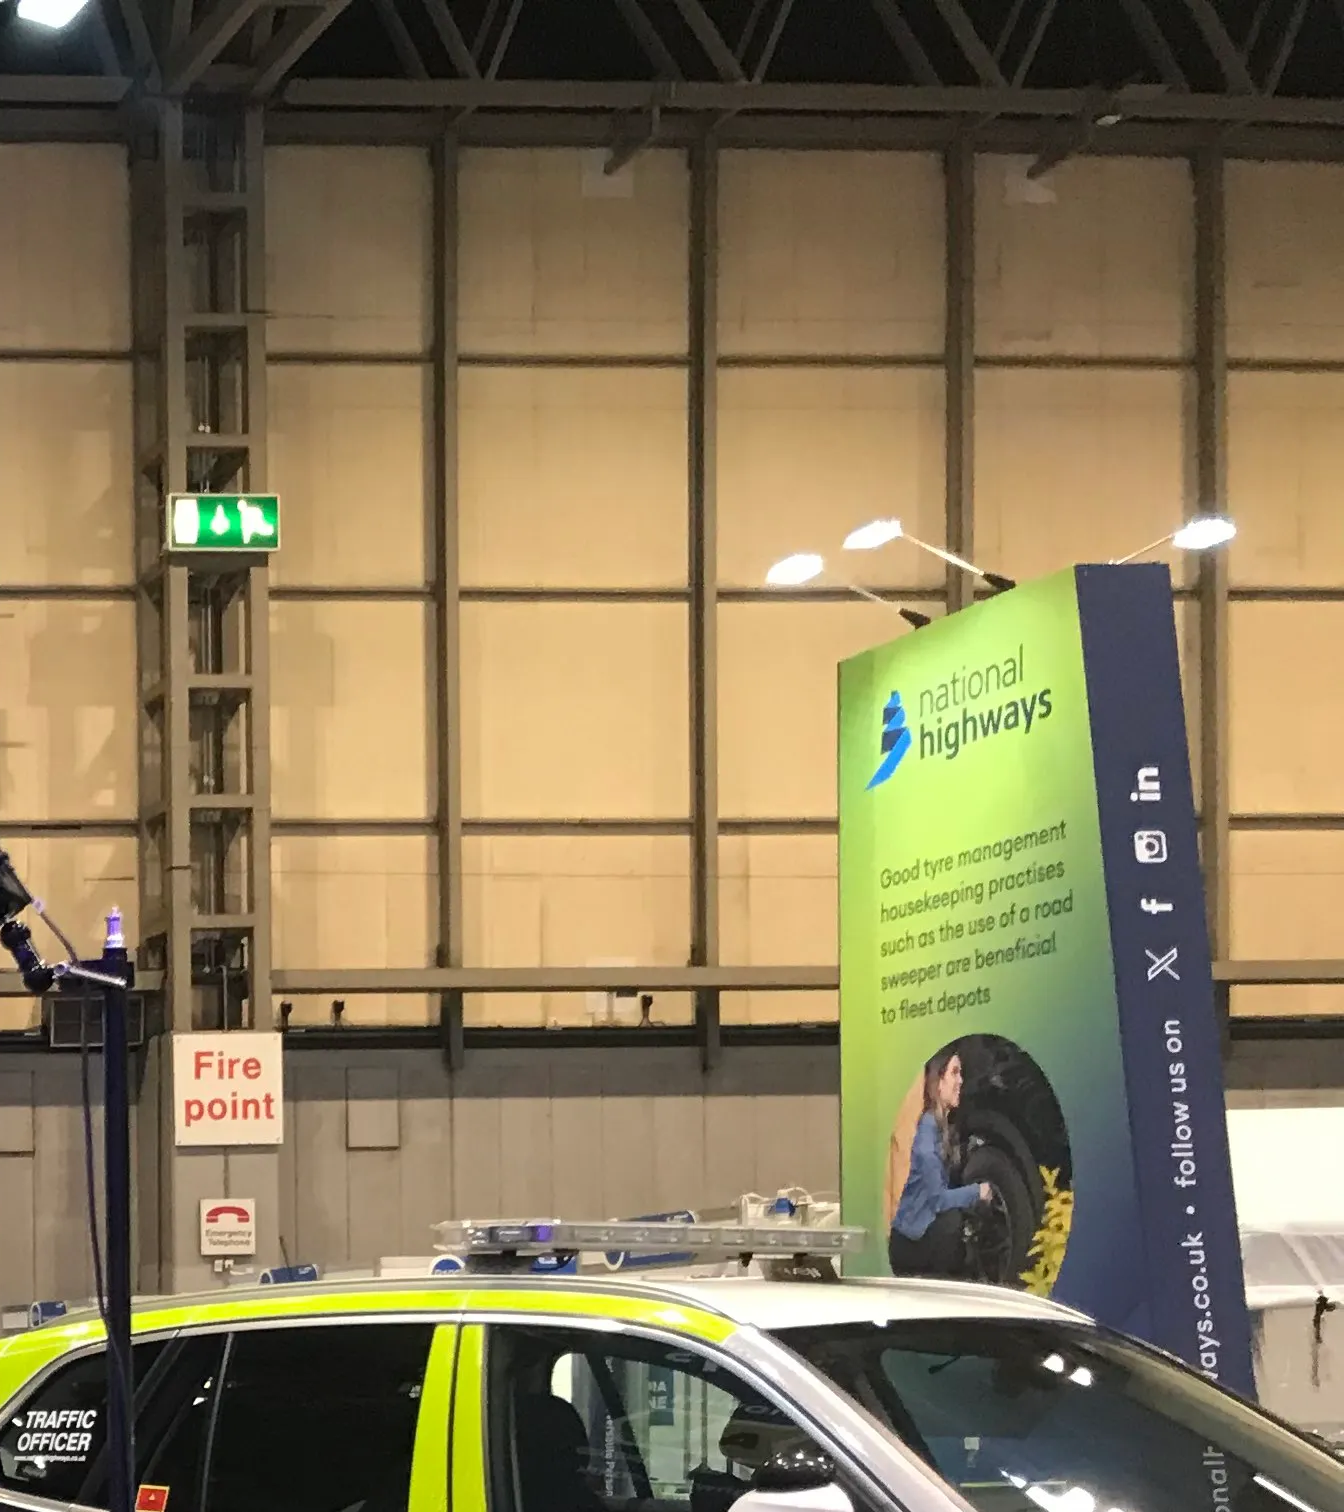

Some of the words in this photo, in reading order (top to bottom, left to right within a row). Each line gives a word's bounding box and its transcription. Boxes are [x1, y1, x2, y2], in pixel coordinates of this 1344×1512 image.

[919, 642, 1024, 718] national
[919, 688, 1053, 760] highways
[880, 858, 920, 889] Good
[923, 856, 953, 880] tyre
[957, 819, 1067, 868] management
[880, 880, 984, 923] housekeeping
[988, 860, 1065, 899] practises
[880, 929, 915, 958] such
[918, 930, 936, 949] as
[939, 920, 964, 942] the
[968, 914, 996, 936] use
[999, 902, 1016, 928] of
[1019, 906, 1030, 924] a
[1034, 888, 1073, 921] road
[880, 962, 943, 992] sweeper
[945, 957, 971, 978] are
[974, 930, 1057, 970] beneficial
[880, 1006, 896, 1025] to
[899, 996, 934, 1021] fleet
[936, 986, 991, 1015] depots
[194, 1051, 261, 1080] Fire
[1165, 1020, 1181, 1054] on
[1170, 1063, 1186, 1093] us
[185, 1091, 275, 1128] point
[1172, 1100, 1197, 1188] follow
[1181, 1231, 1220, 1379] ays.co.uk
[17, 1432, 92, 1452] OFFICER
[26, 1409, 98, 1429] TRAFFIC
